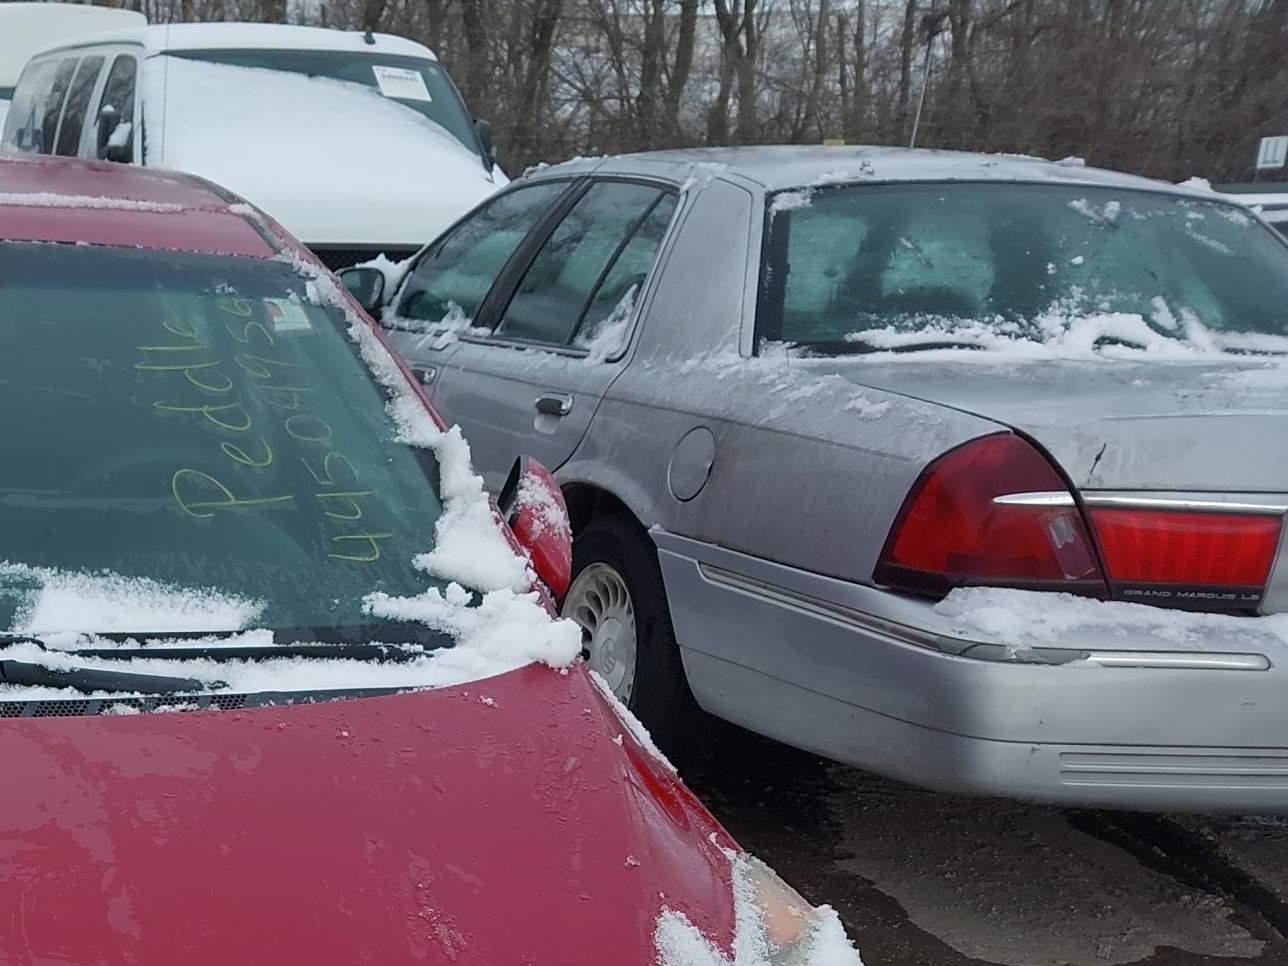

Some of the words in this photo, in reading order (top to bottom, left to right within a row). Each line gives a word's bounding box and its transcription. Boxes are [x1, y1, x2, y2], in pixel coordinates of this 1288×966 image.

[134, 319, 295, 518] Peddle
[1123, 589, 1172, 598] GRAND
[1176, 591, 1236, 600] MARQUIS
[1241, 593, 1260, 601] LS
